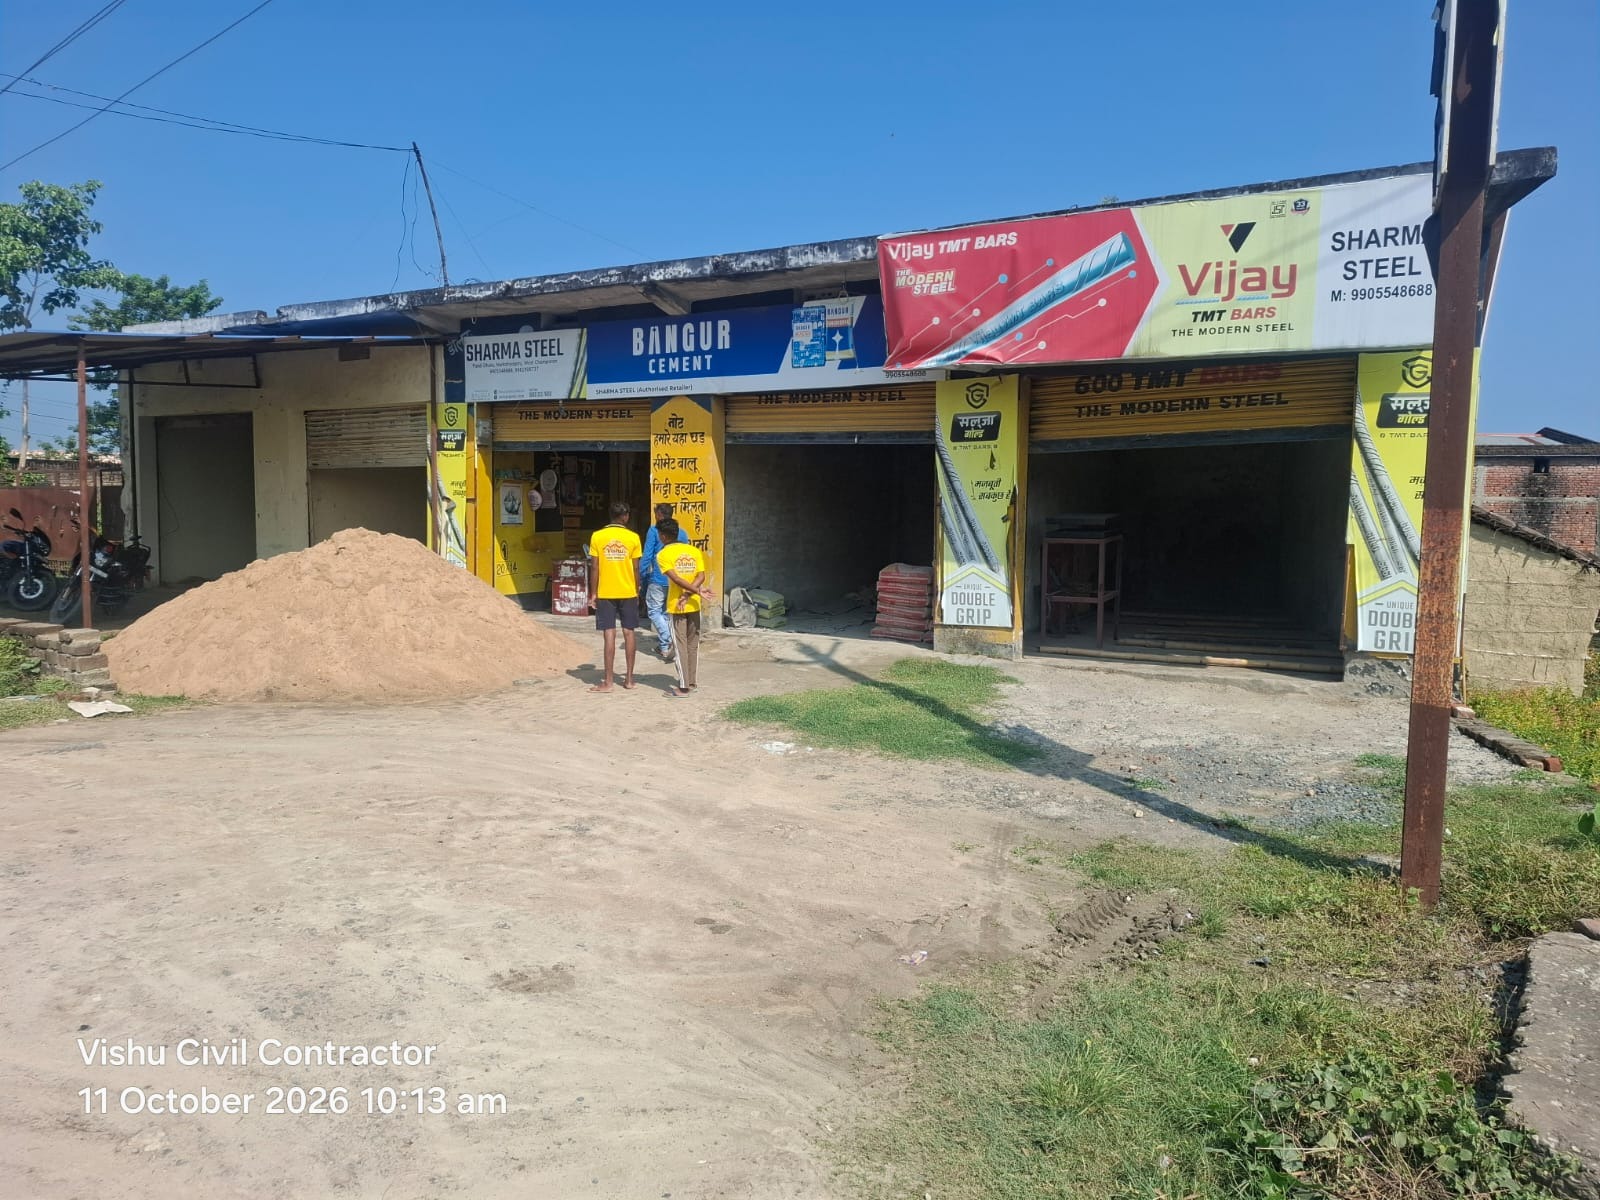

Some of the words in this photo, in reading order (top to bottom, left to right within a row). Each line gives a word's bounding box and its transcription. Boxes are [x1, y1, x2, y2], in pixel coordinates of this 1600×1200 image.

[888, 242, 934, 262] Vijay
[939, 238, 971, 254] TMT
[974, 232, 1018, 250] BARS
[1330, 224, 1425, 252] SHARM
[895, 269, 912, 277] THE
[1342, 256, 1422, 281] STEEL
[895, 271, 955, 288] MODERN
[1177, 260, 1298, 302] Vijay
[912, 283, 956, 296] STEEL
[1330, 290, 1347, 302] M:
[1351, 283, 1433, 301] 9905548688
[1191, 309, 1226, 323] TMT
[1230, 306, 1277, 321] BARS
[631, 319, 731, 356] BANGUR
[1171, 328, 1194, 337] THE
[1198, 325, 1250, 336] MODERN
[1256, 323, 1295, 333] STEEL
[466, 341, 521, 362] SHARMA
[525, 337, 564, 358] STEEL
[648, 354, 713, 375] CEMENT
[1074, 375, 1124, 395] 600
[1133, 370, 1186, 390] TMT
[758, 393, 783, 404] THE
[788, 391, 852, 404] MODERN
[859, 389, 906, 402] STEEL
[1075, 404, 1112, 418] THE
[1119, 396, 1210, 415] MODERN
[1219, 392, 1289, 409] STEEL
[519, 410, 540, 420] THE
[544, 408, 593, 420] MODERN
[597, 408, 634, 419] STEEL
[653, 429, 671, 447] हमारे
[951, 591, 996, 607] DOUBLE
[1386, 601, 1415, 610] UNIQUE
[956, 607, 992, 625] GRIP
[1367, 610, 1414, 628] DOUB
[1373, 630, 1410, 651] GRI
